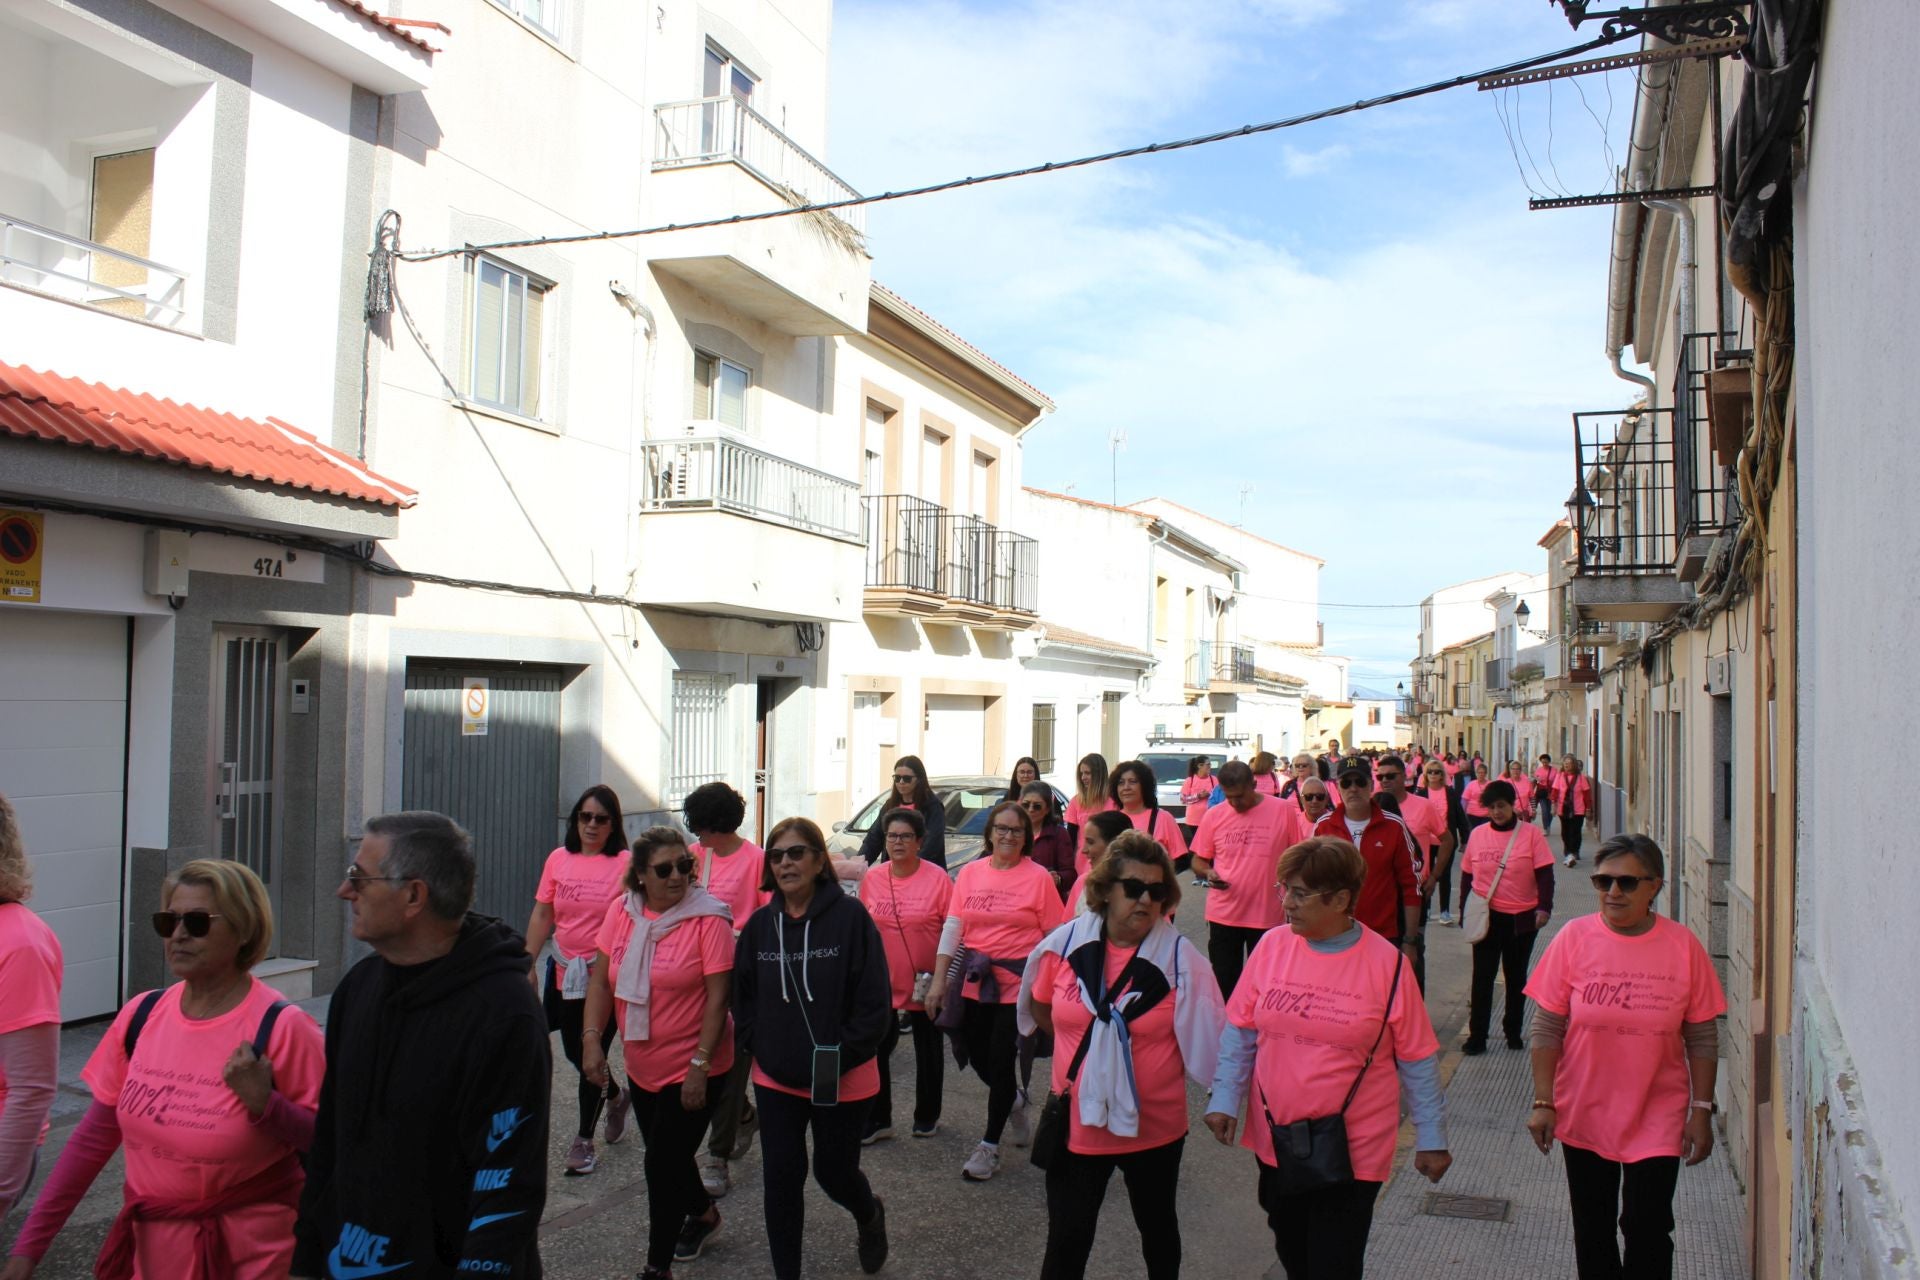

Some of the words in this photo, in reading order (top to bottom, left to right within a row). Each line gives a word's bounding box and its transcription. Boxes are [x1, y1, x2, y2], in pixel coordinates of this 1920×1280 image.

[254, 558, 283, 577] 47A
[1261, 988, 1307, 1014] 100%
[1582, 982, 1625, 1007] 100%
[473, 1167, 513, 1192] NIKE
[340, 1222, 391, 1267] NIKE
[457, 1257, 512, 1274] WOOSH
